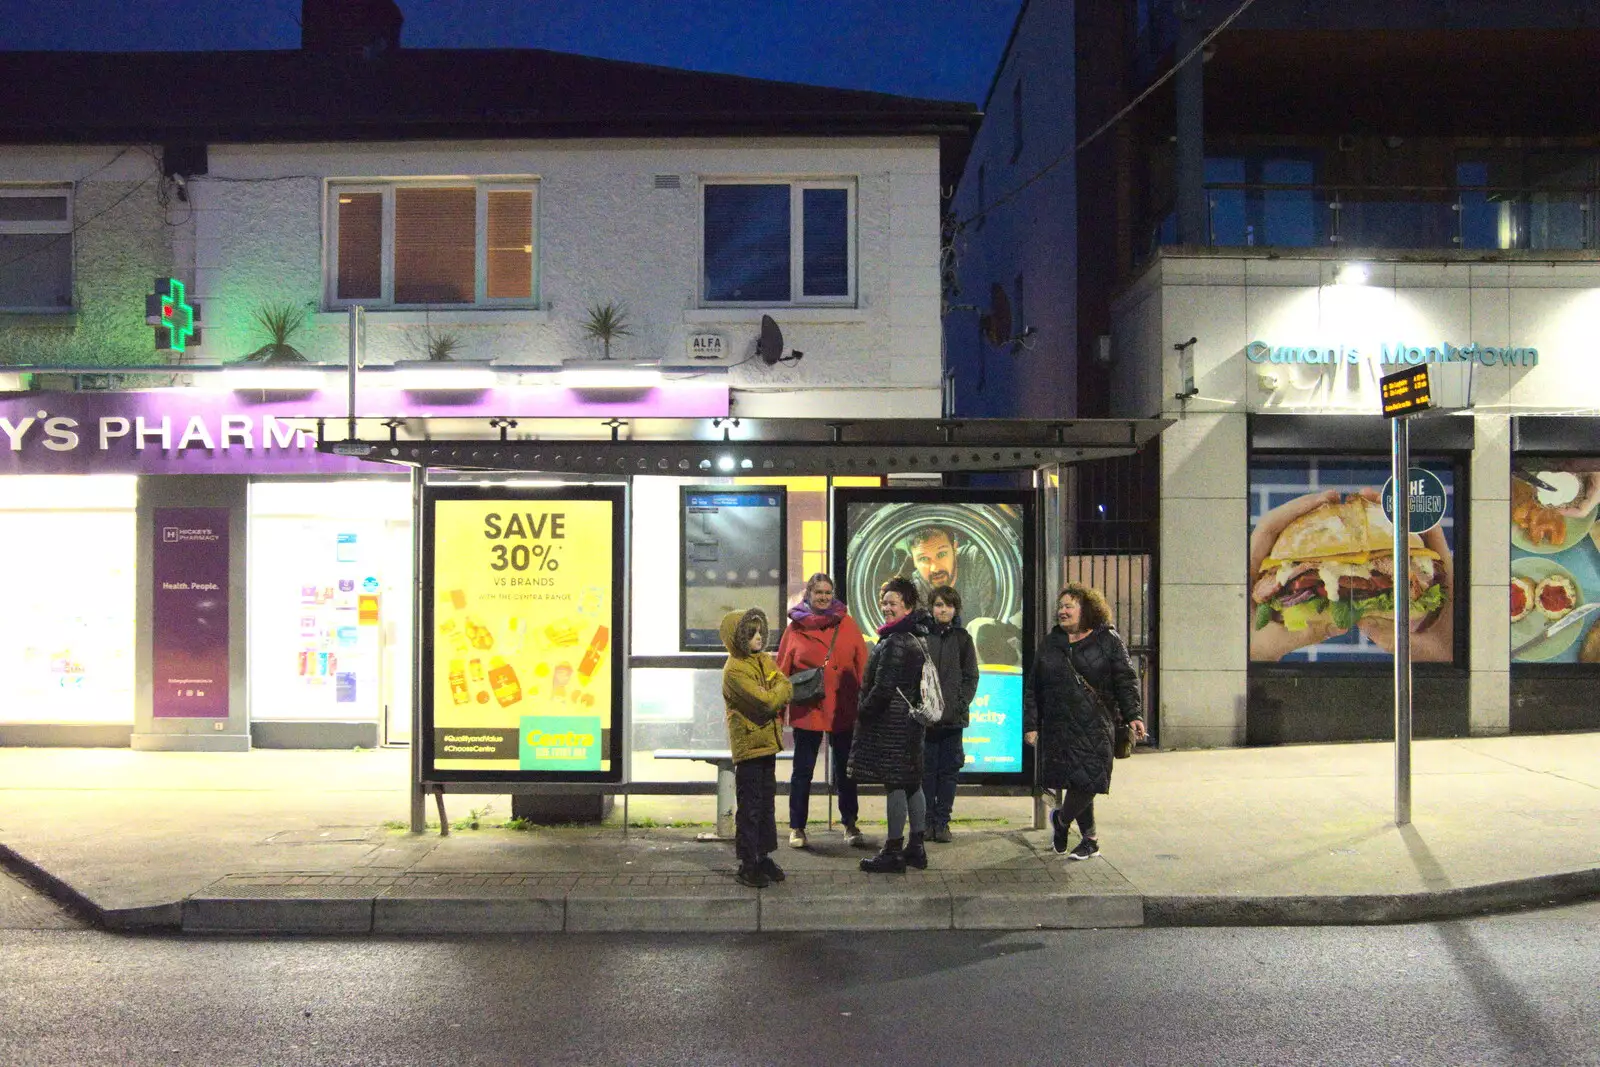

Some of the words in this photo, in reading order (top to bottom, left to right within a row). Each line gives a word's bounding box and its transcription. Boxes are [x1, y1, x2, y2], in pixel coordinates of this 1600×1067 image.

[693, 338, 721, 348] ALFA
[1379, 341, 1539, 367] Monkstown
[98, 414, 319, 450] PHARM
[1409, 479, 1426, 496] HE
[1386, 495, 1442, 513] KCHEN
[484, 512, 566, 540] SAVE
[162, 582, 190, 590] Health.
[191, 582, 220, 592] People.
[493, 577, 507, 586] VS
[510, 577, 555, 587] BRANDS
[975, 694, 990, 707] of
[968, 710, 1007, 725] ricity
[526, 729, 595, 747] Centra
